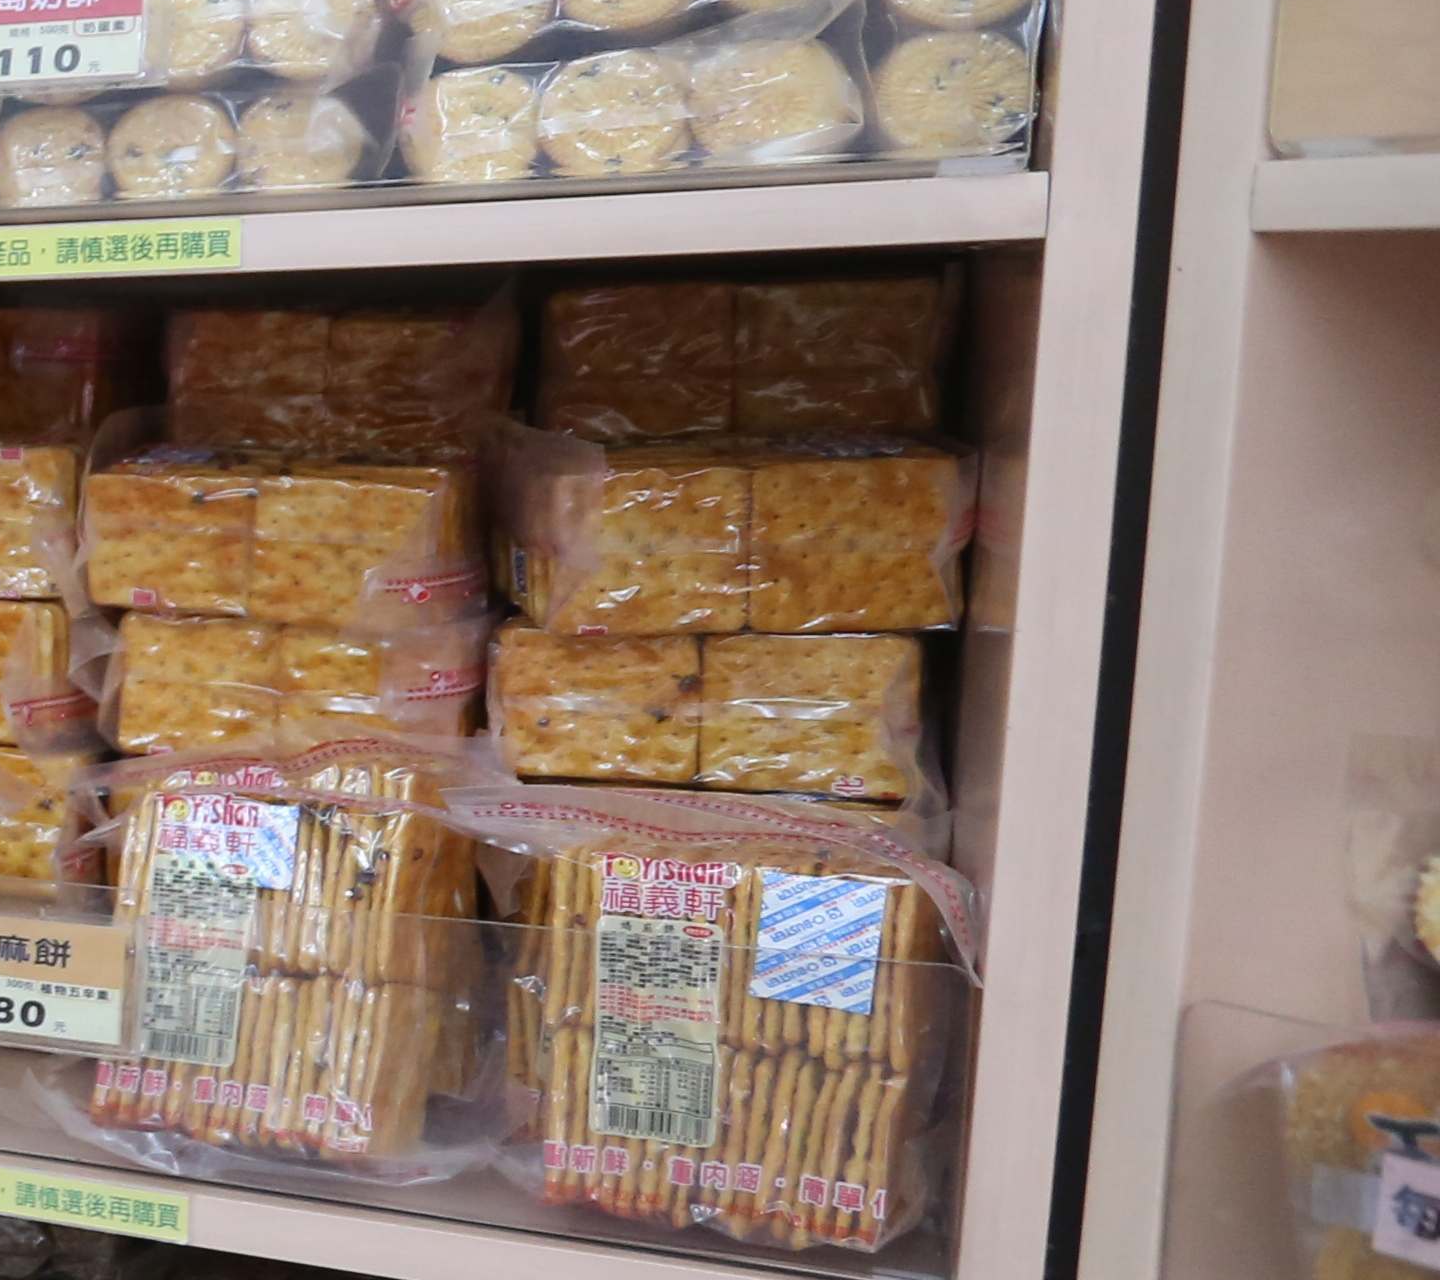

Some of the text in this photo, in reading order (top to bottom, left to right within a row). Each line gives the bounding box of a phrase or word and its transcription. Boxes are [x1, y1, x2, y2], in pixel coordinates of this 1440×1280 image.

[86, 60, 102, 73] 元
[157, 823, 257, 856] 福義軒
[600, 883, 725, 919] 福義軒
